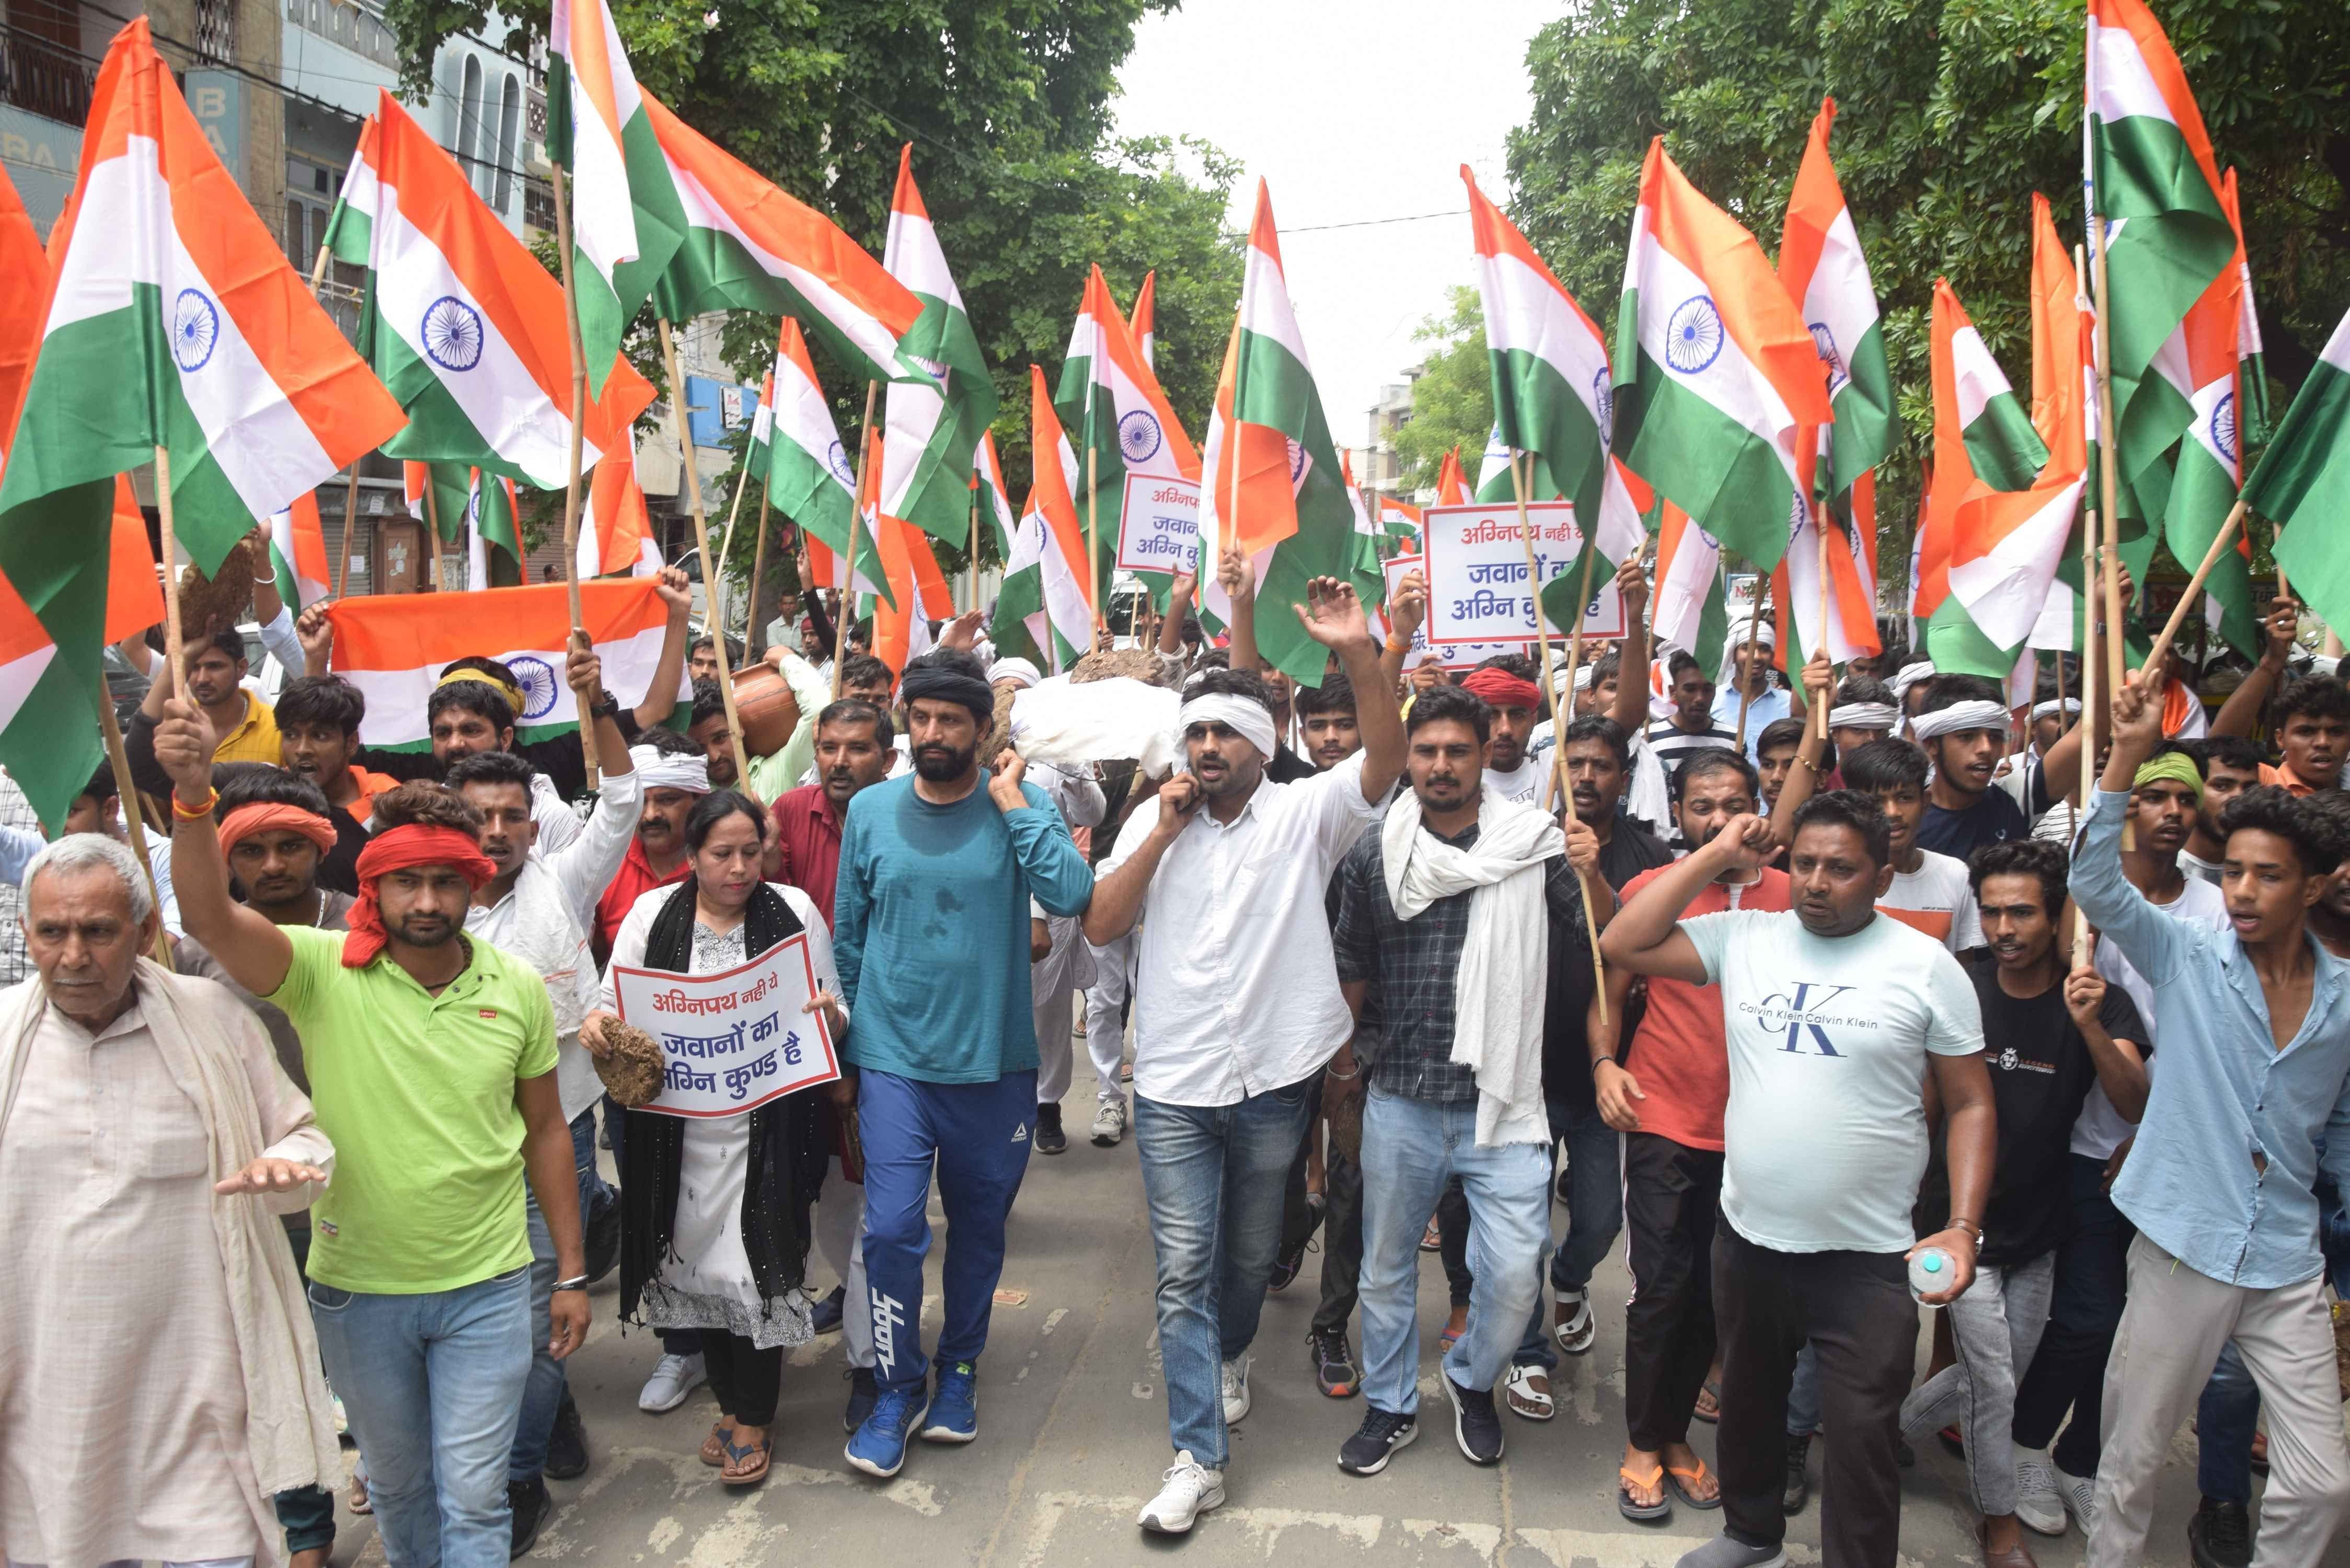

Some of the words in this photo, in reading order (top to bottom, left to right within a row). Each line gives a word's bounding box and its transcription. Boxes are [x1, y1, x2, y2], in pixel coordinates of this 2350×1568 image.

[1136, 534, 1183, 558] अग्नि
[1451, 589, 1515, 620] अग्नि
[653, 988, 737, 1016] अग्निपथ
[741, 978, 766, 1004] नही
[768, 971, 778, 989] ये
[661, 1020, 746, 1058] जवानों
[750, 1010, 779, 1042] का
[1739, 1002, 1772, 1017] Calvin
[1777, 1009, 1803, 1022] Klein
[1805, 1013, 1842, 1025] Calvin
[1846, 1018, 1877, 1029] Klein
[723, 1048, 778, 1100] कुण्ड
[781, 1030, 802, 1065] है
